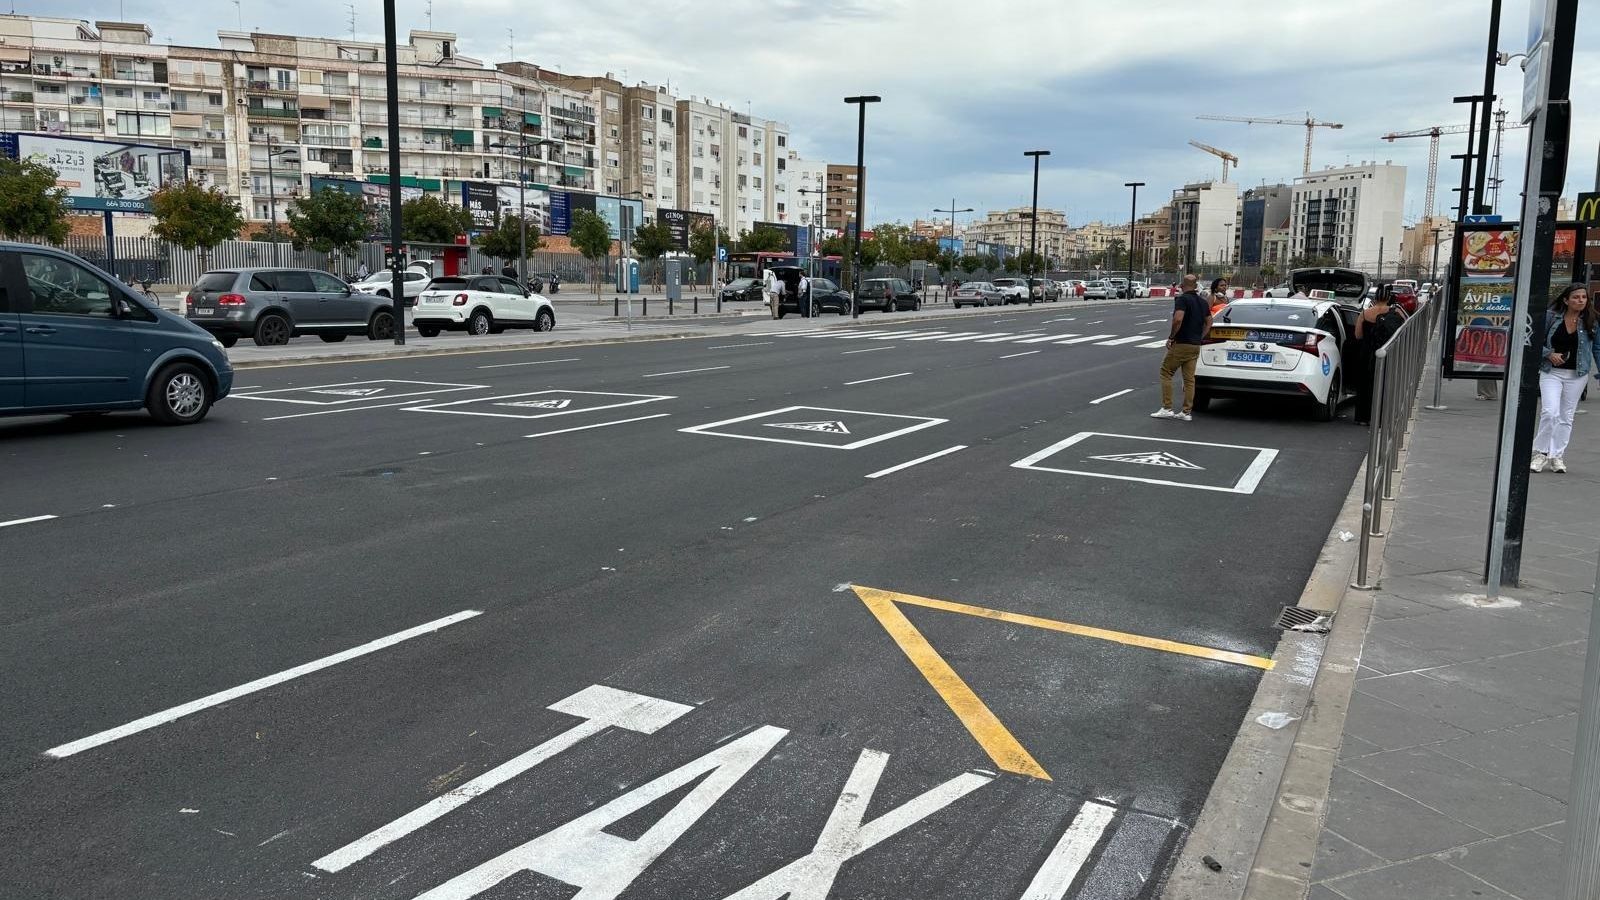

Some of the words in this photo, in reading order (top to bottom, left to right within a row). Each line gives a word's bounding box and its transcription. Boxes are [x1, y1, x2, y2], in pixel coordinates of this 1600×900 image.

[66, 154, 72, 164] 2
[78, 156, 84, 166] 3
[470, 200, 482, 209] MÁS
[665, 212, 684, 220] GINOS
[720, 248, 726, 260] P
[1463, 288, 1500, 303] Ávila
[1254, 354, 1271, 362] LFJ
